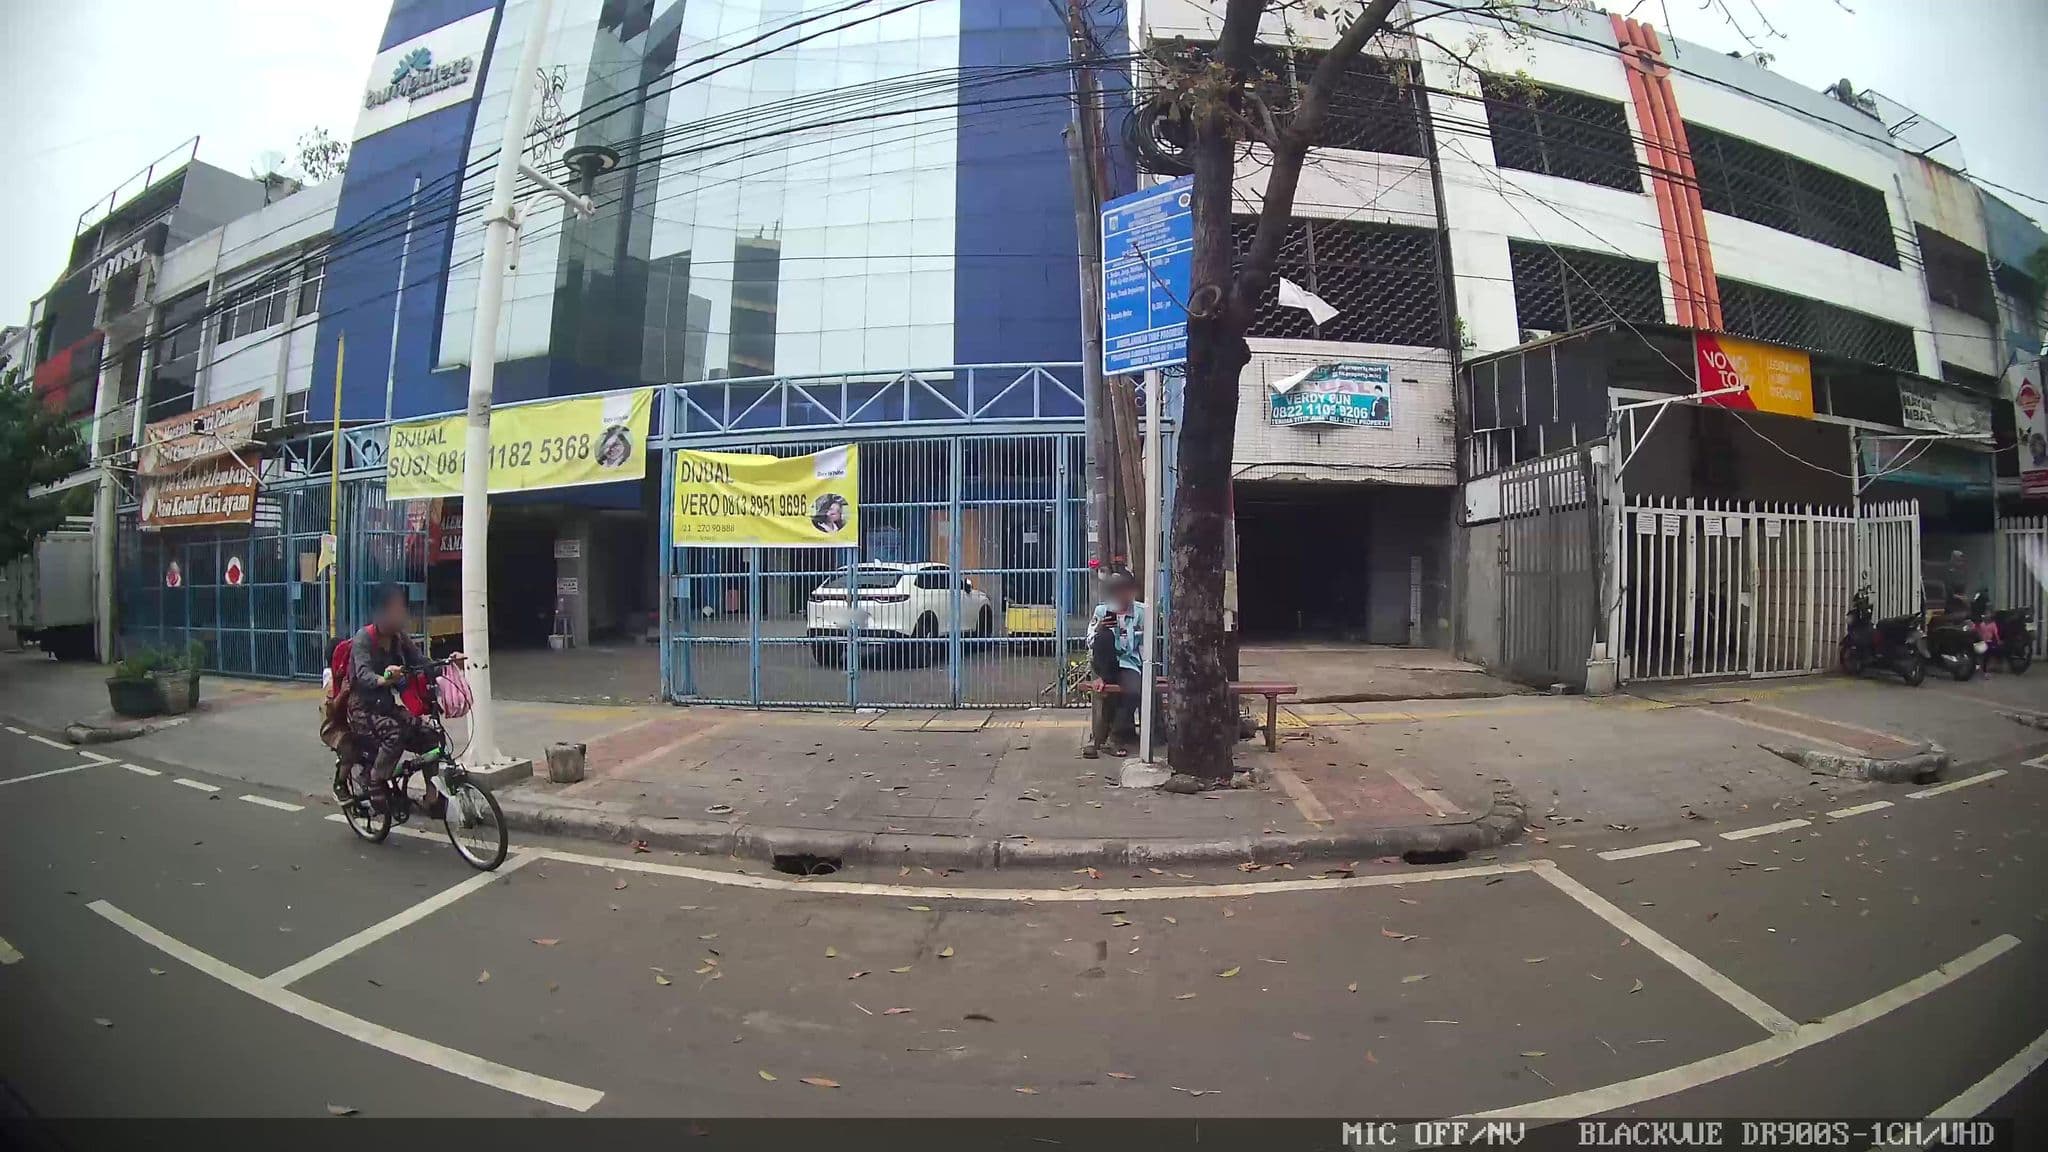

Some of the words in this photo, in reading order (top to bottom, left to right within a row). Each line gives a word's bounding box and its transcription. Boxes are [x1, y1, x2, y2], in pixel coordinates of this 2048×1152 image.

[1286, 393, 1326, 405] VERDY
[1273, 405, 1303, 418] 0822
[1340, 406, 1368, 418] 9206
[395, 428, 446, 448] DIJUAL
[389, 452, 430, 478] SUSI
[488, 441, 532, 470] 1182
[540, 433, 590, 463] 5368
[681, 461, 734, 484] DIJUAL
[200, 491, 221, 514] Kari
[222, 494, 250, 517] ayam
[681, 494, 719, 515] VERO
[722, 494, 747, 516] 0813
[750, 494, 775, 516] 8951
[780, 494, 807, 516] 9696
